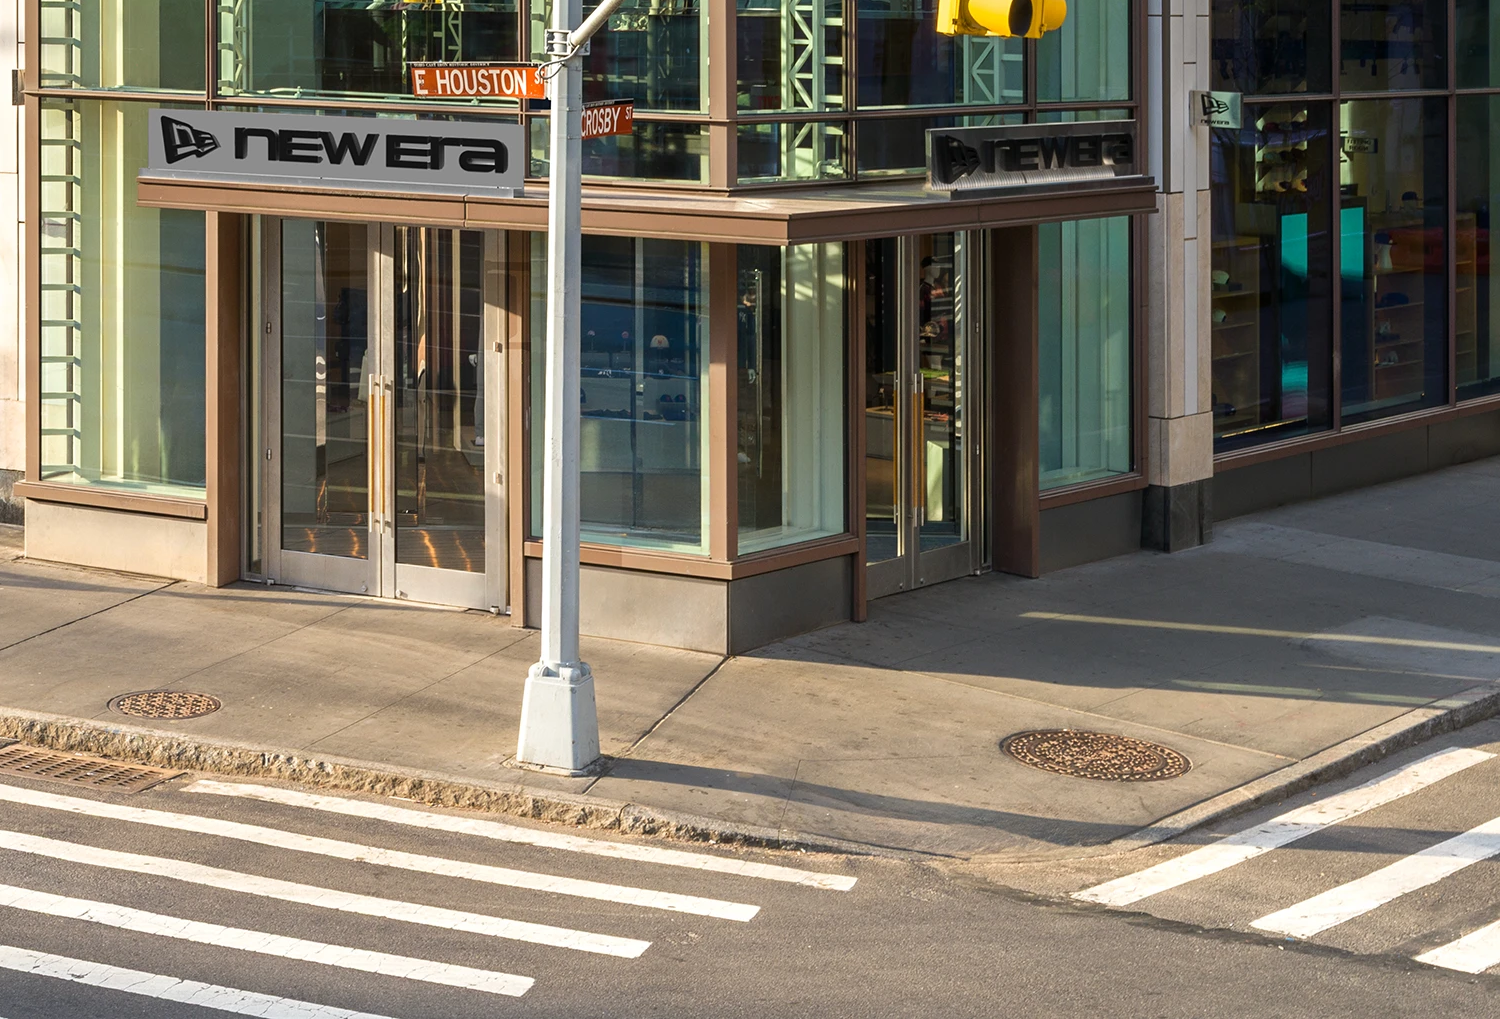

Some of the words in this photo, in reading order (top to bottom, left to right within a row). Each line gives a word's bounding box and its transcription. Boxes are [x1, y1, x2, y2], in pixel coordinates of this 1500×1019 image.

[414, 69, 429, 95] E
[436, 69, 528, 96] HOUSTON
[581, 104, 621, 137] CROSBY
[625, 106, 633, 120] ST
